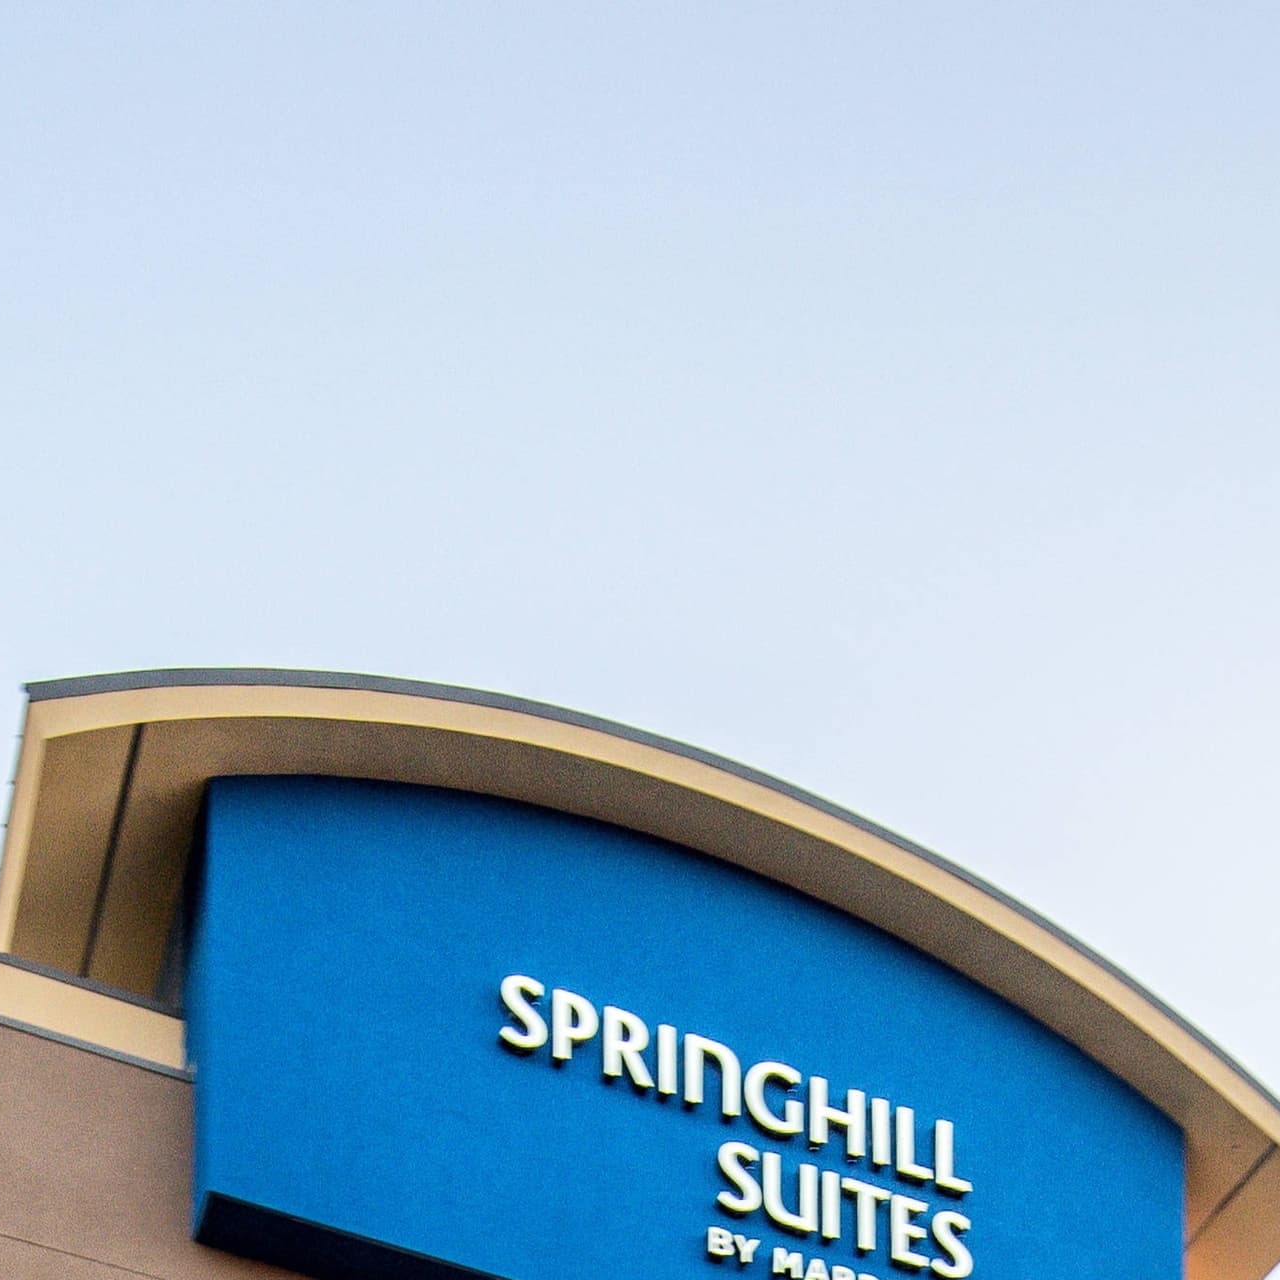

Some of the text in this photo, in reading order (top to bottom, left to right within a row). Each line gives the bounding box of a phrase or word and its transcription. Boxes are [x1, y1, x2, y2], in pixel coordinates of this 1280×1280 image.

[499, 974, 973, 1193] SPRINGHILL
[707, 1226, 761, 1264] BY
[716, 1141, 974, 1280] SUITES
